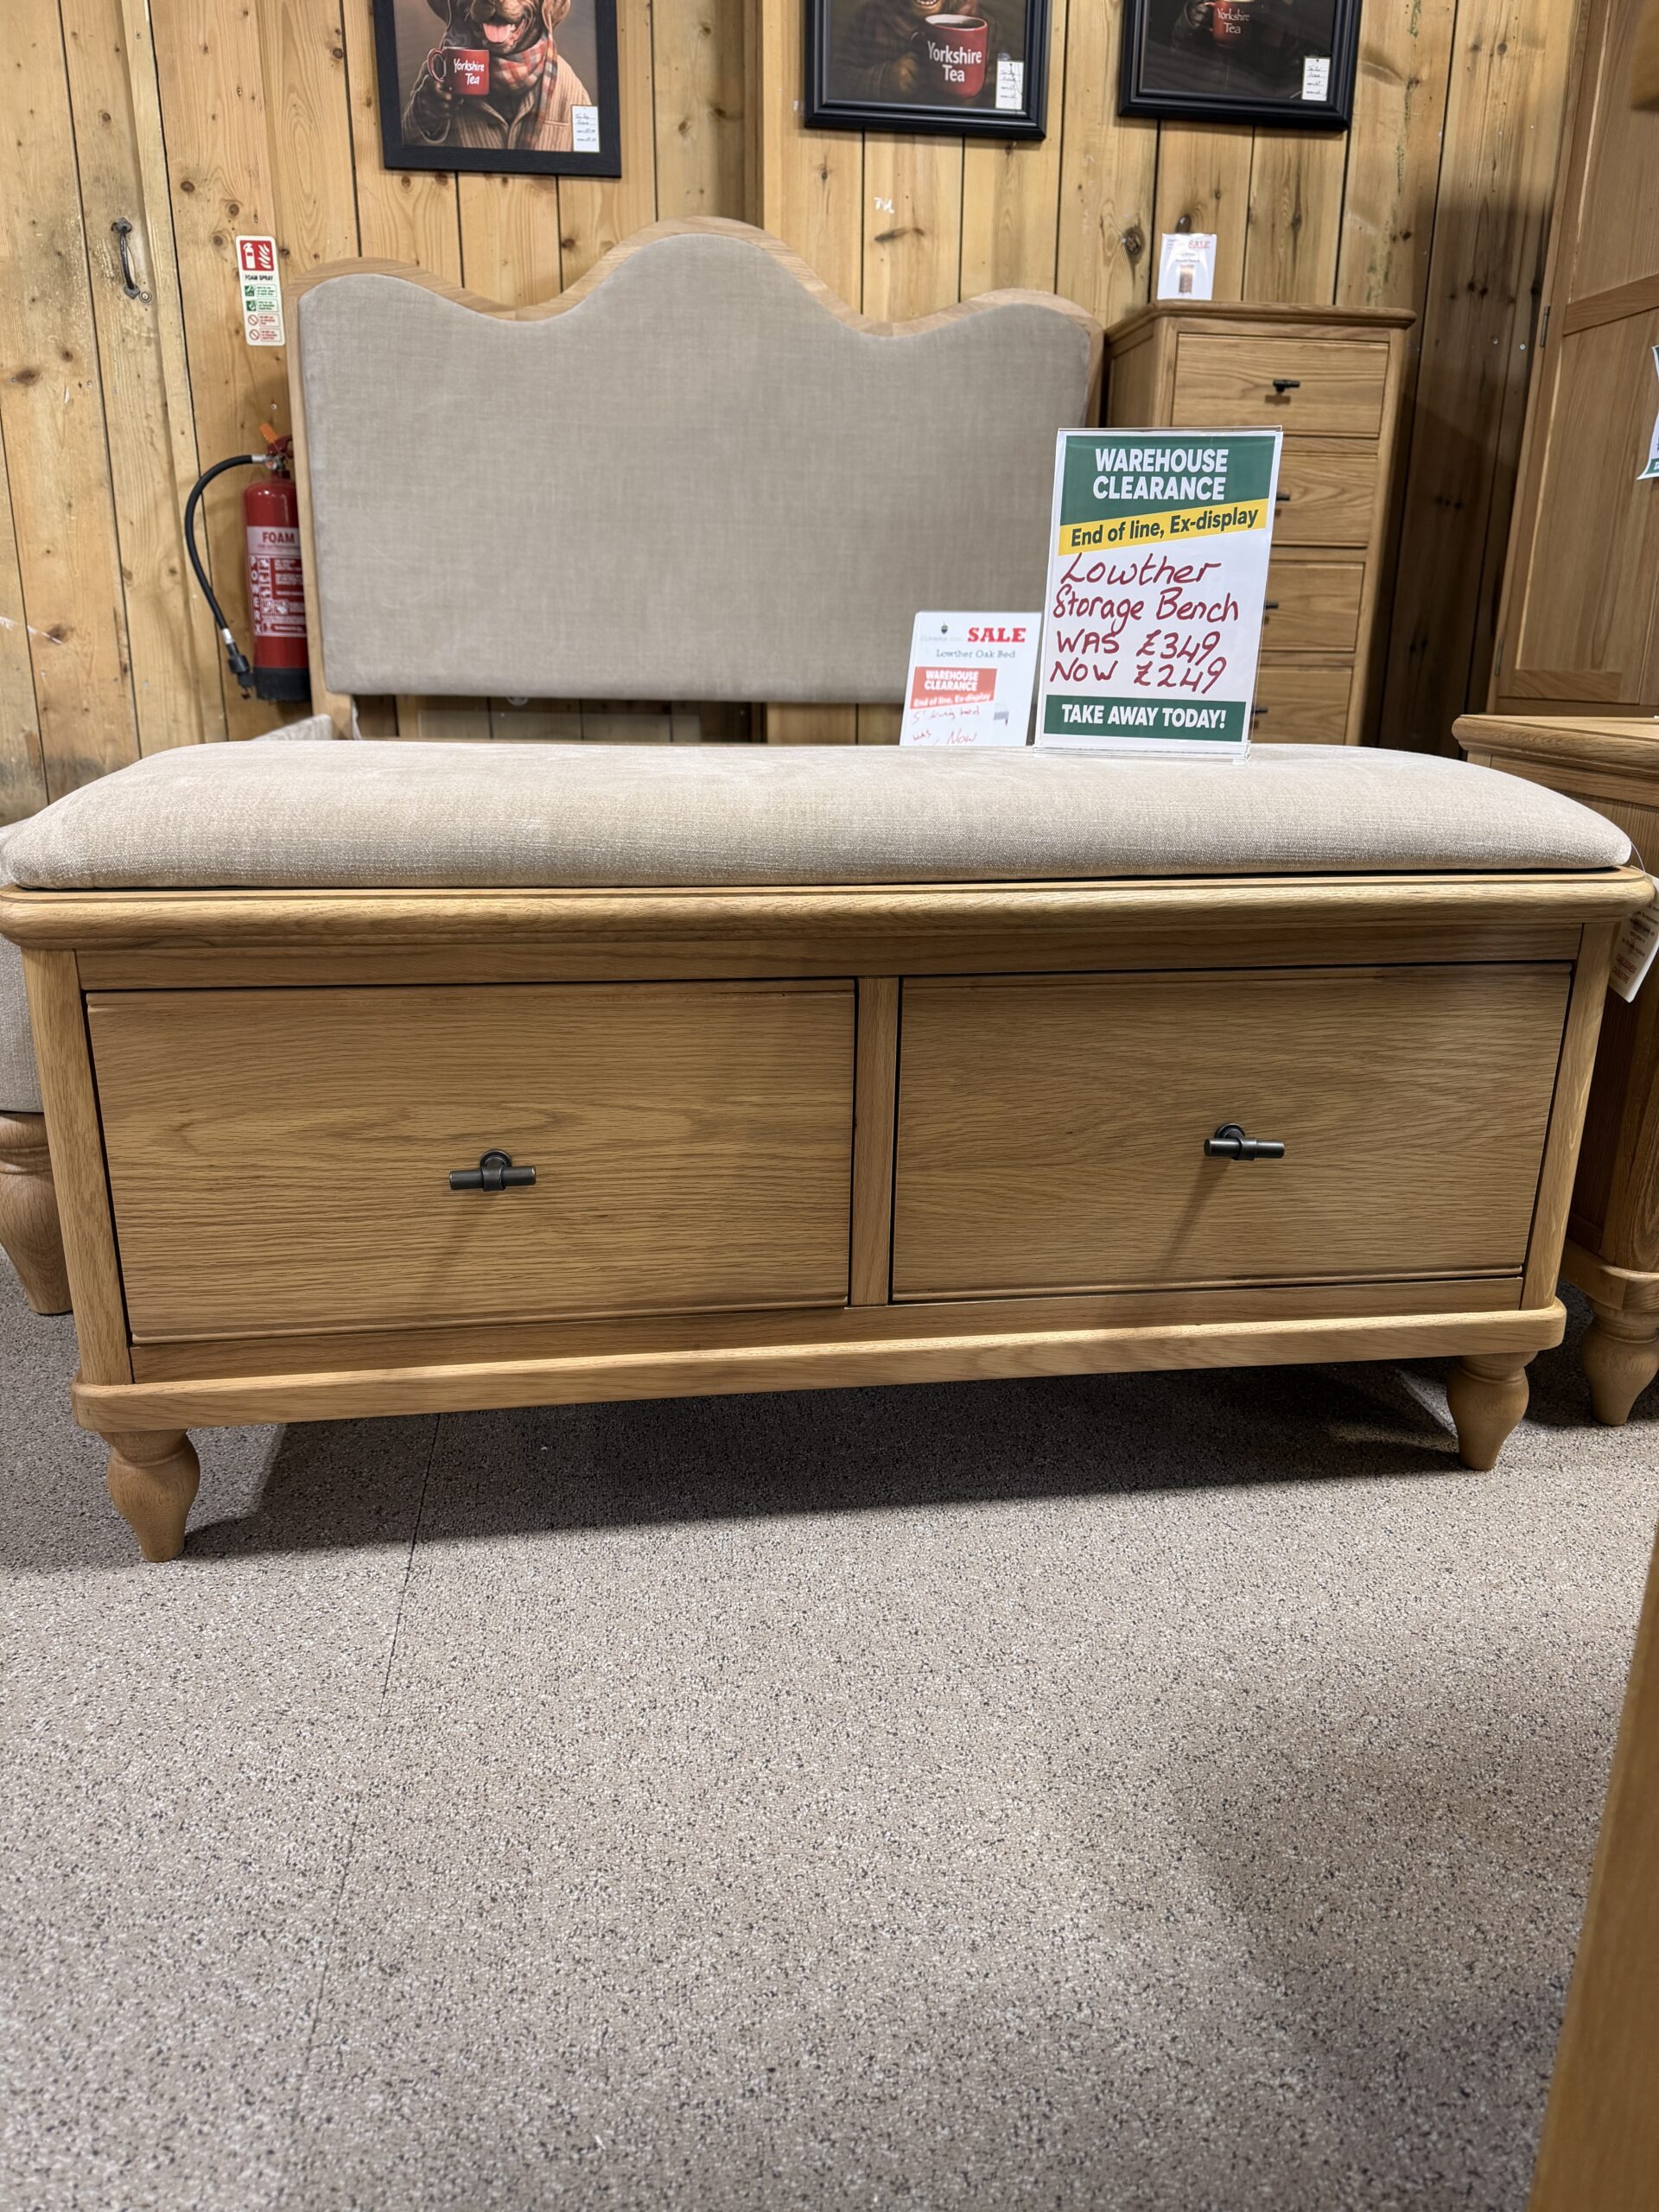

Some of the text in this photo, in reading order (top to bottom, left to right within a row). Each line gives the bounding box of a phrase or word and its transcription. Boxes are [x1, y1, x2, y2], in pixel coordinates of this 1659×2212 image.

[1217, 8, 1250, 22] Yorkshire
[1224, 22, 1242, 35] Tea
[926, 41, 982, 65] Yorkshire
[453, 58, 485, 73] Yorkshire
[942, 64, 965, 83] Tea
[465, 73, 480, 86] Tea
[1095, 448, 1230, 474] WAREHOUSE
[1092, 476, 1226, 501] CLEARANCE
[1071, 507, 1259, 547] End of line, Ex-display
[263, 531, 296, 543] FOAM
[1060, 552, 1222, 586] Lowther
[1052, 584, 1239, 635] Storage Bench
[968, 627, 1027, 643] SALE
[976, 650, 995, 658] Oak
[1057, 628, 1221, 667] WAS £349
[925, 670, 979, 682] WAREHOUSE
[1049, 656, 1228, 694] NOW £249
[924, 680, 978, 691] CLEARANCE
[1061, 703, 1226, 729] TAKE AWAY TODAY!
